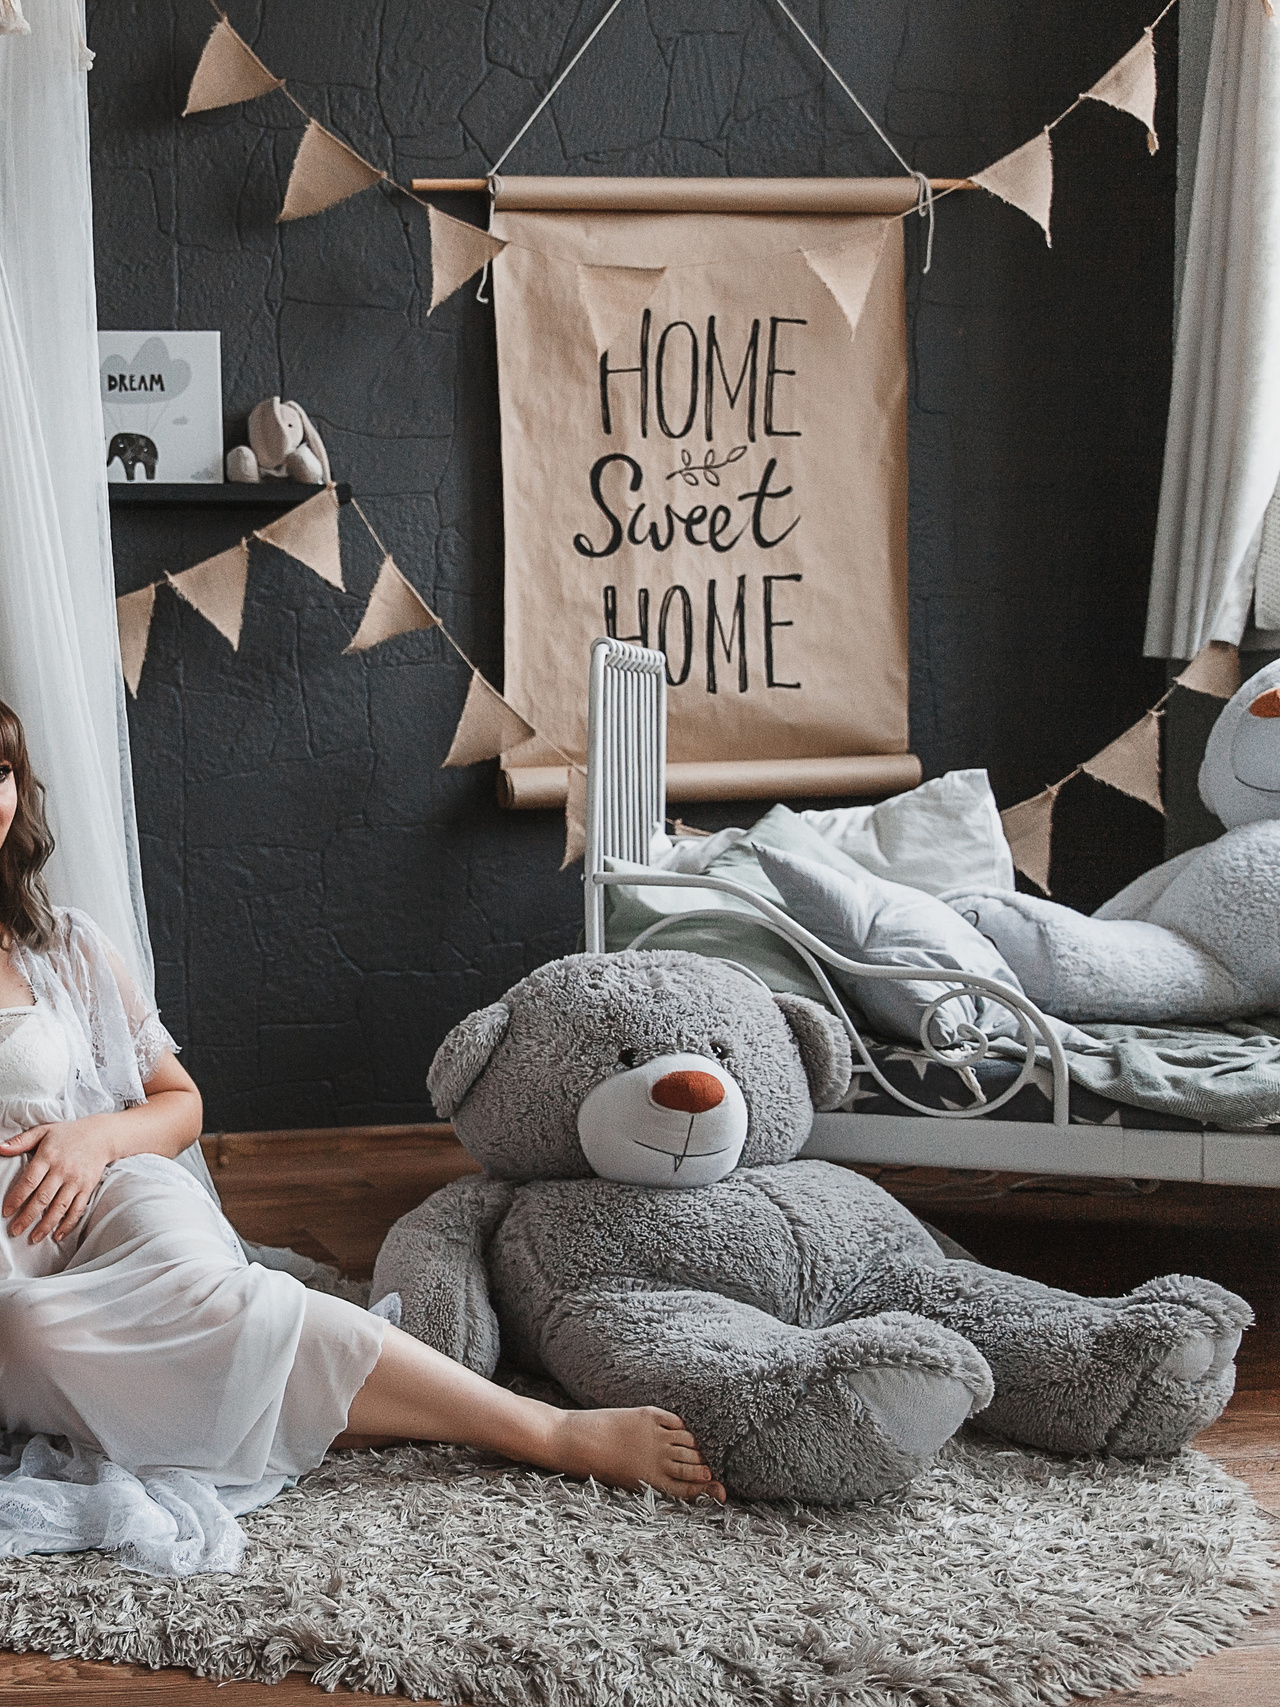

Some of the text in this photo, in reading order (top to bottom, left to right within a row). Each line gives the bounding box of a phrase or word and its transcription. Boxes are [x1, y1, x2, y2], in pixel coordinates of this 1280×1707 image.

[107, 374, 166, 392] DREAM
[599, 308, 810, 443] HOME
[573, 453, 801, 558] Sweet
[604, 574, 803, 694] HOME
